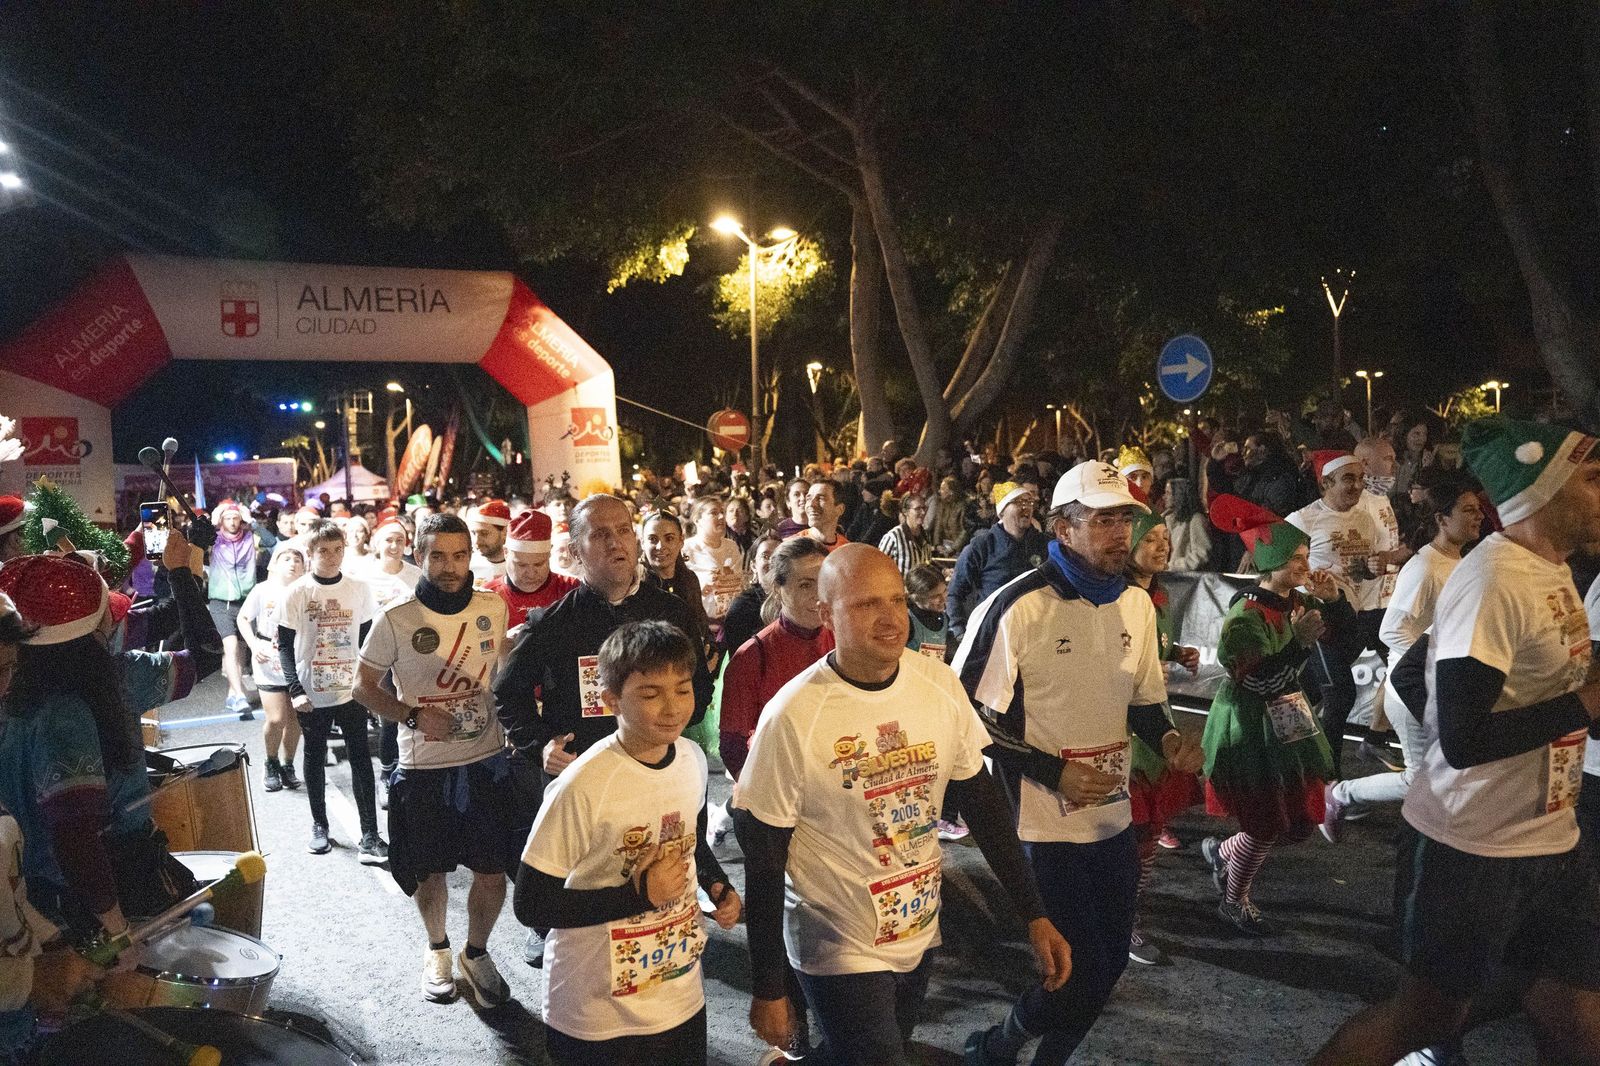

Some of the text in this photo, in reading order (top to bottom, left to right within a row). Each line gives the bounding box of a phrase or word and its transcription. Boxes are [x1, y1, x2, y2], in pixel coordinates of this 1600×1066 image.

[296, 284, 451, 313] ALMERÍA
[296, 317, 377, 335] CIUDAD
[89, 318, 143, 366] deporte
[527, 338, 571, 379] deporte
[857, 741, 937, 778] SILVESTRE
[863, 773, 893, 789] Ciudad
[896, 771, 905, 780] de
[891, 802, 921, 823] 2005
[900, 884, 938, 918] 1970
[638, 938, 688, 969] 1971
